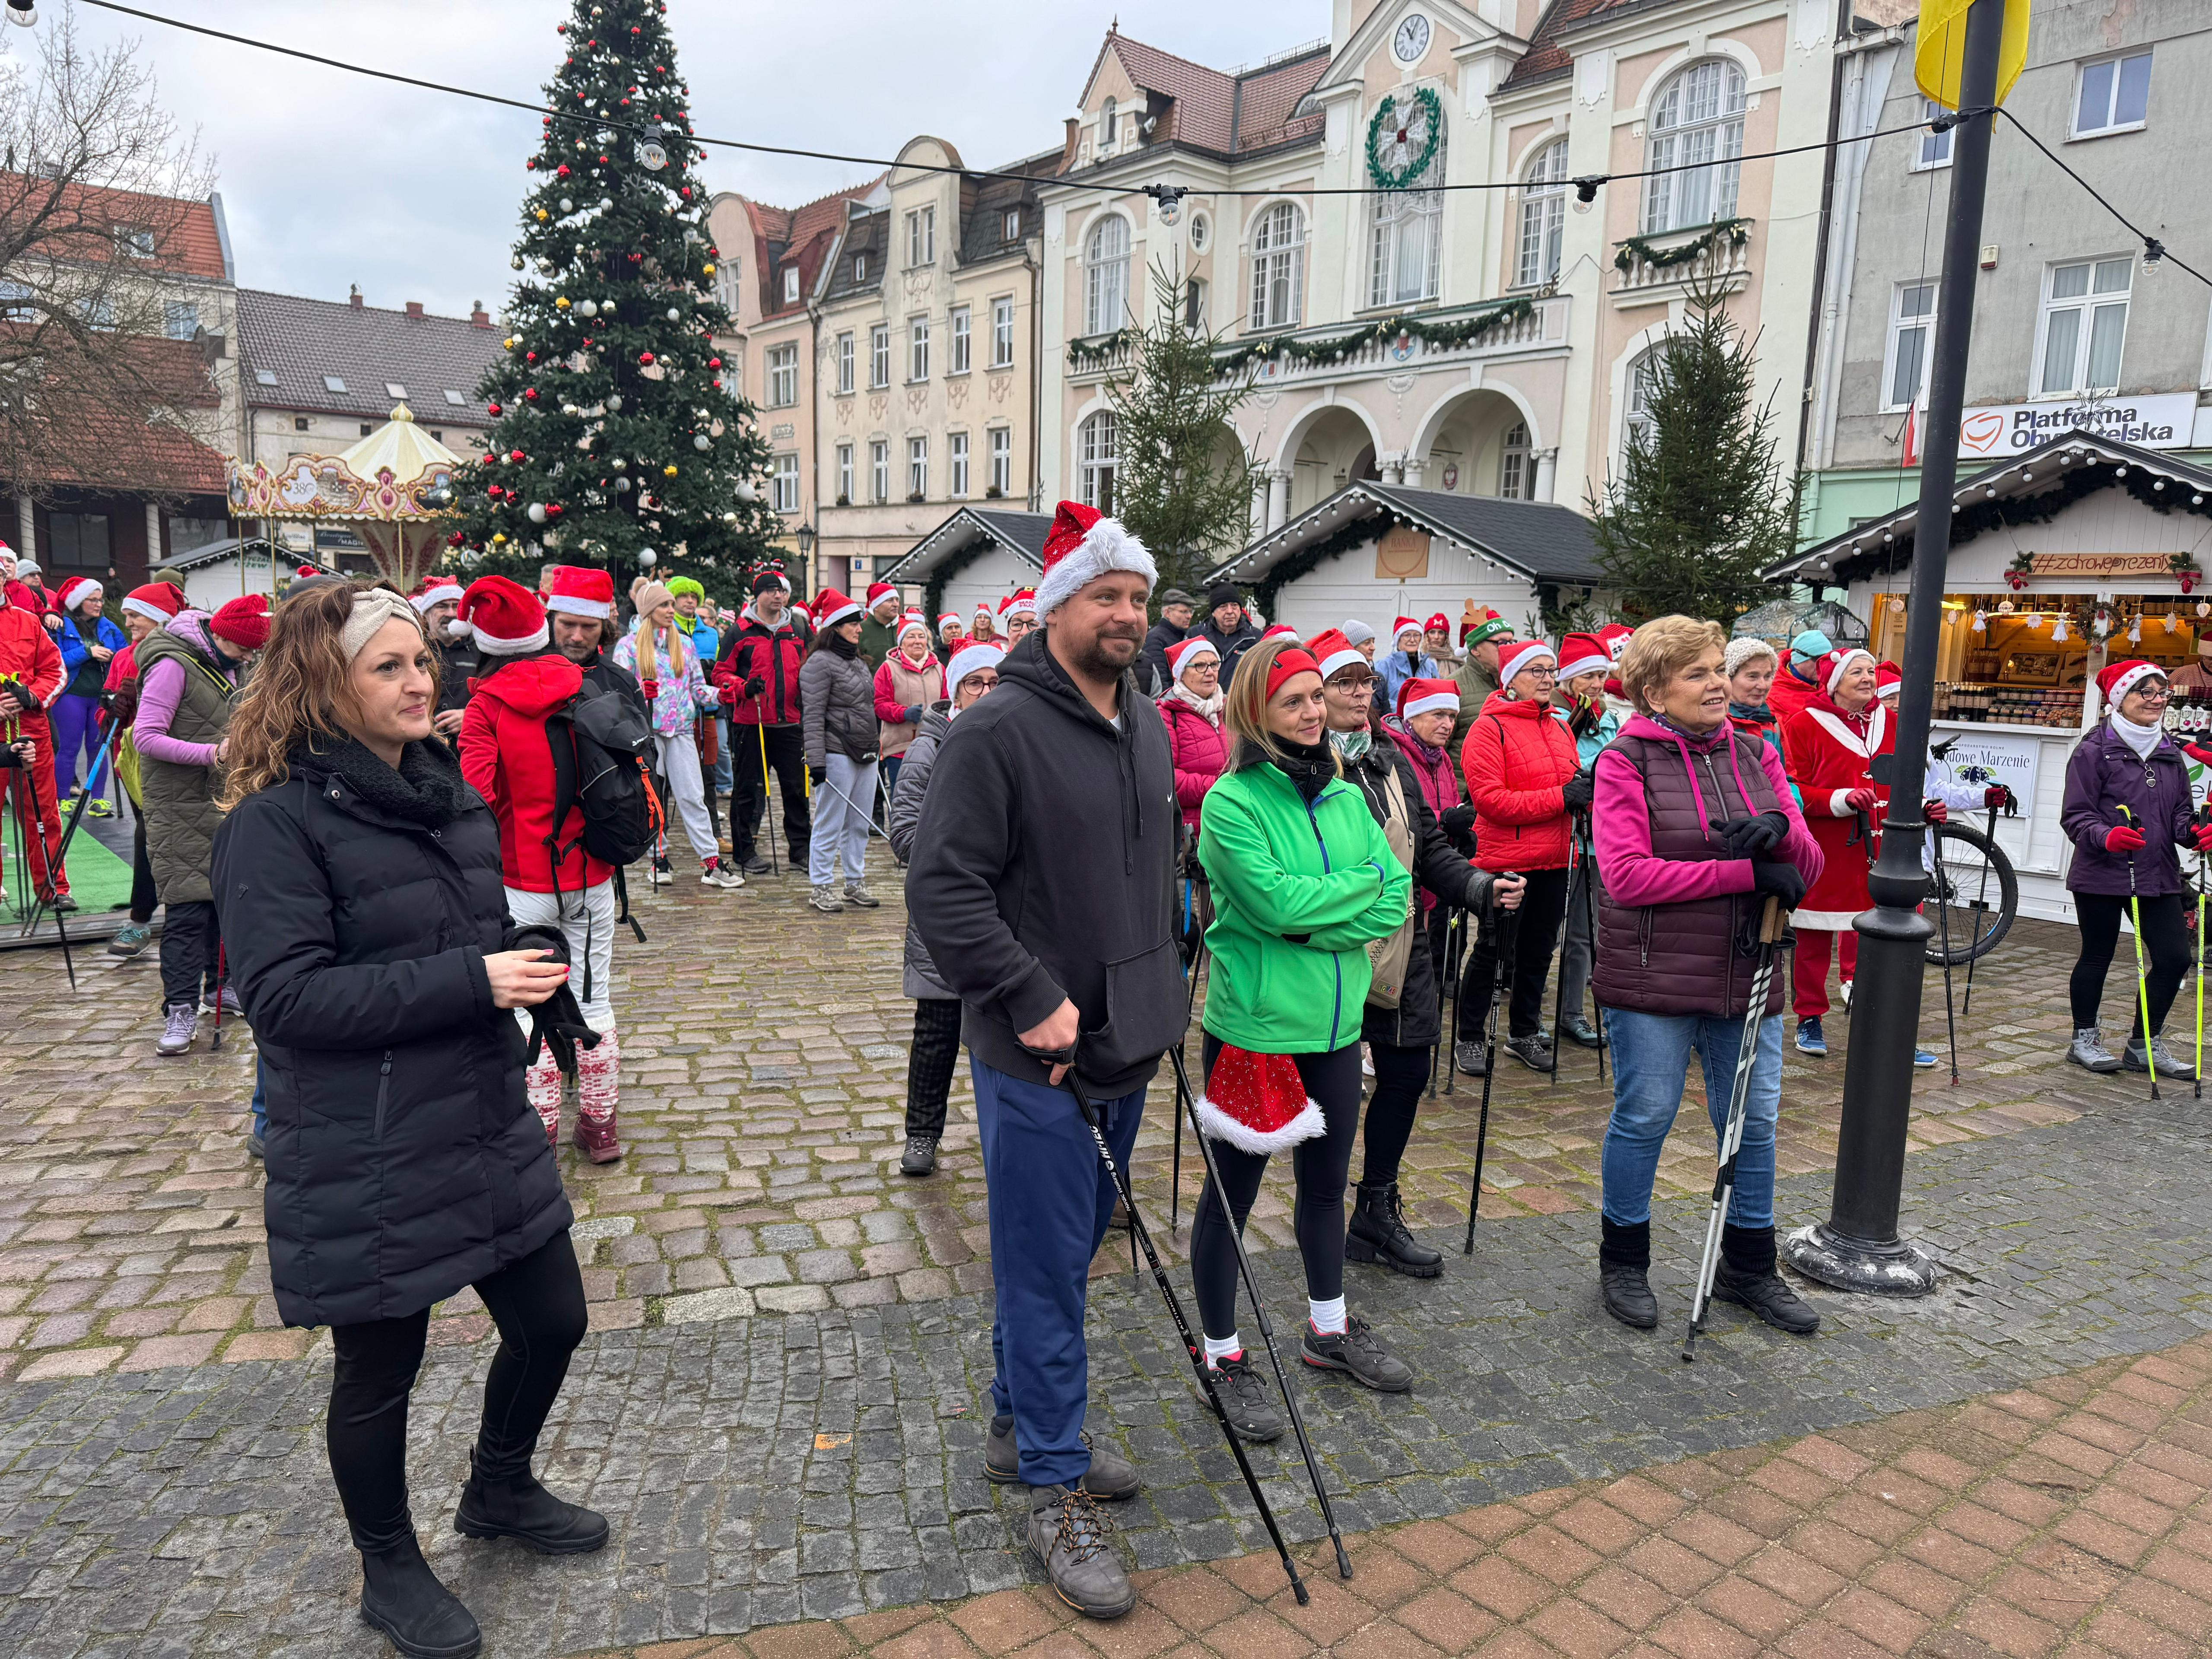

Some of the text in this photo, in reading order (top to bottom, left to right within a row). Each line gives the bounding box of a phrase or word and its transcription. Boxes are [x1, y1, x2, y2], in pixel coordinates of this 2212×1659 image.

[2011, 422, 2174, 448] Obtelska
[1487, 622, 1502, 632] Oh
[1936, 749, 2030, 768] odowe Marzenie
[1089, 1125, 1111, 1159] HI-TEC
[1110, 1172, 1131, 1211] Nordic Walking
[1162, 1285, 1184, 1330] ANTISHOCK
